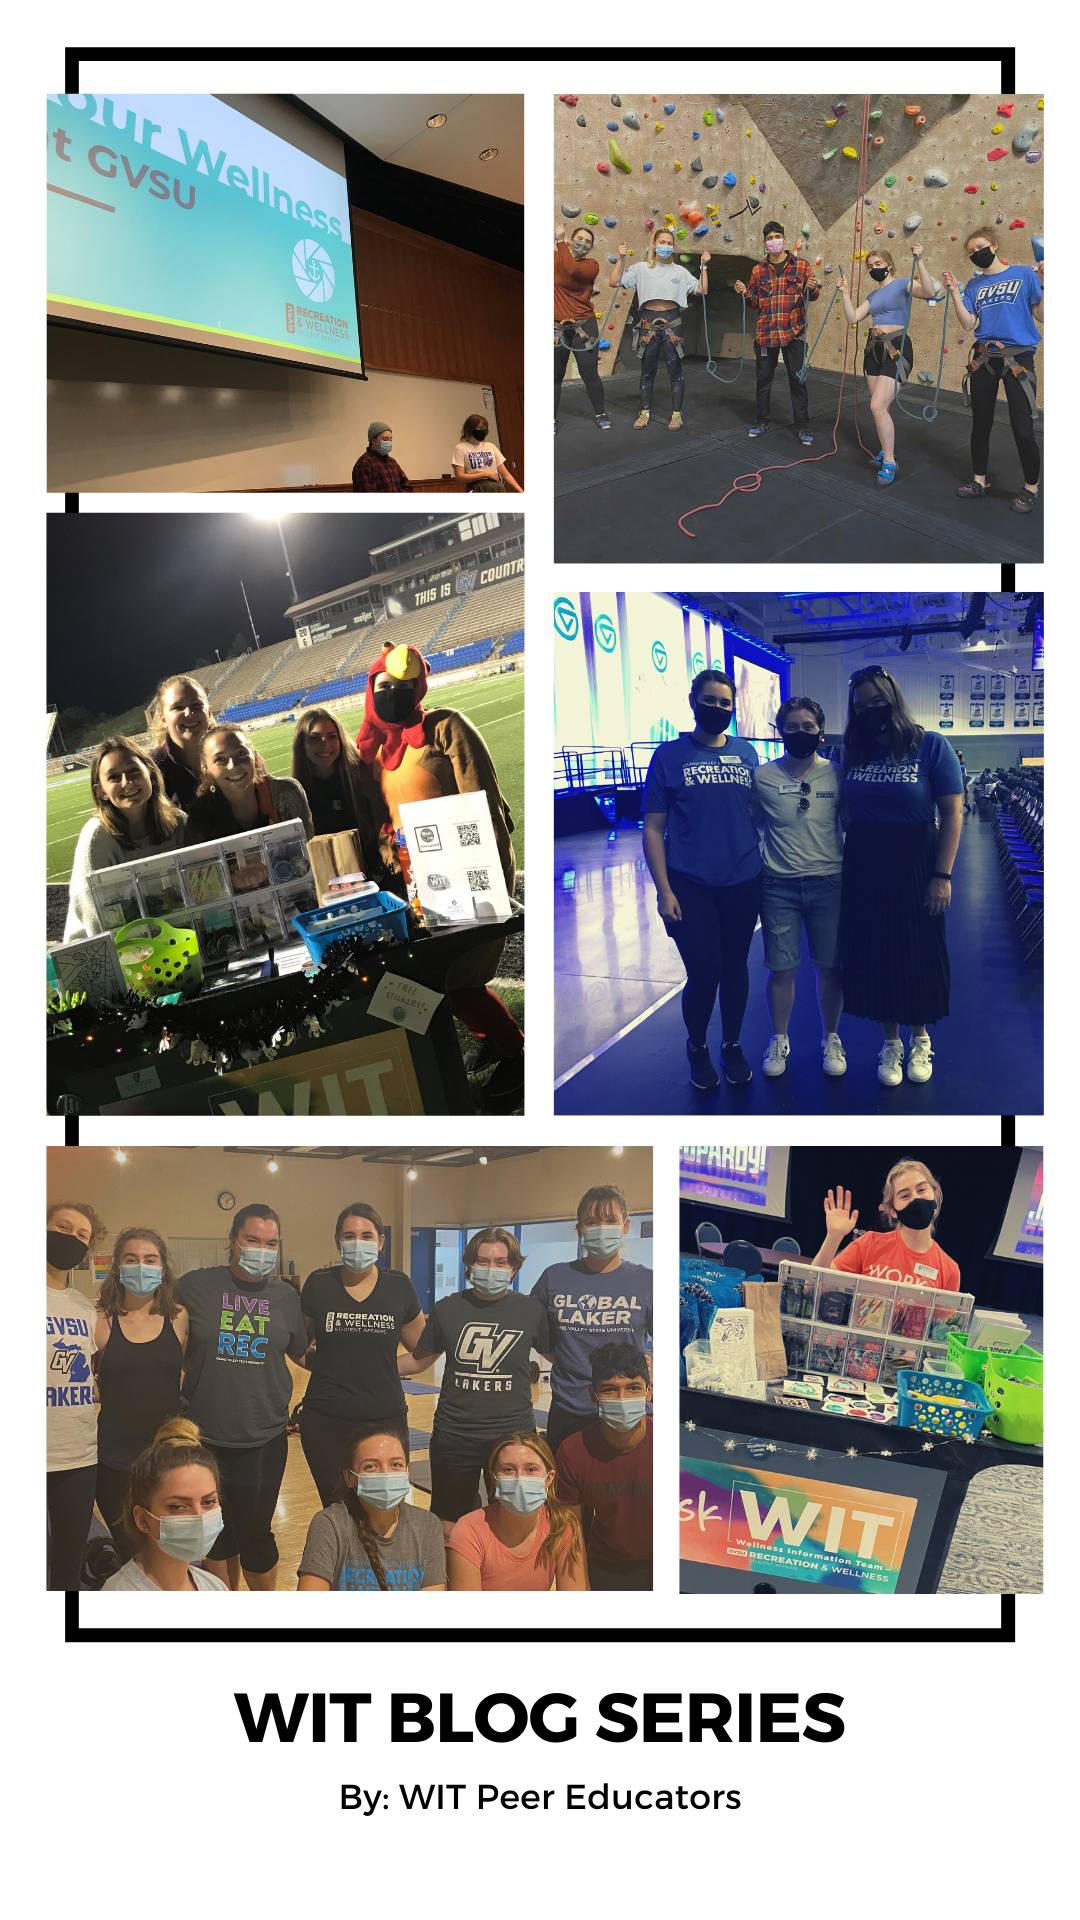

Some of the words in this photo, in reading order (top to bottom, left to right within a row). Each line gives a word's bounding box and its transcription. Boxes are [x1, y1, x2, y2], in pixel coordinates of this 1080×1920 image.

[47, 94, 161, 150] our
[178, 127, 344, 237] Wellness
[88, 145, 196, 210] GVSU
[978, 281, 1020, 300] GVSU
[415, 588, 437, 607] THIS
[440, 583, 451, 598] IS
[685, 777, 695, 786] &
[852, 771, 919, 783] WELLNESS
[222, 1292, 270, 1315] LIVE
[220, 1310, 271, 1335] EAT
[335, 1319, 341, 1327] &
[345, 1320, 395, 1330] WELLNESS
[336, 1312, 395, 1322] RECREATION
[558, 1308, 632, 1325] LAKER
[218, 1331, 269, 1359] REC
[455, 1321, 524, 1373] GV
[455, 1378, 512, 1391] LAKERS
[740, 1489, 895, 1560] WIT
[736, 1538, 784, 1553] Wellness
[787, 1548, 851, 1565] Information
[856, 1560, 884, 1571] Team
[749, 1551, 819, 1569] RECREATION
[821, 1564, 828, 1572] &
[832, 1566, 889, 1582] WELLNESS
